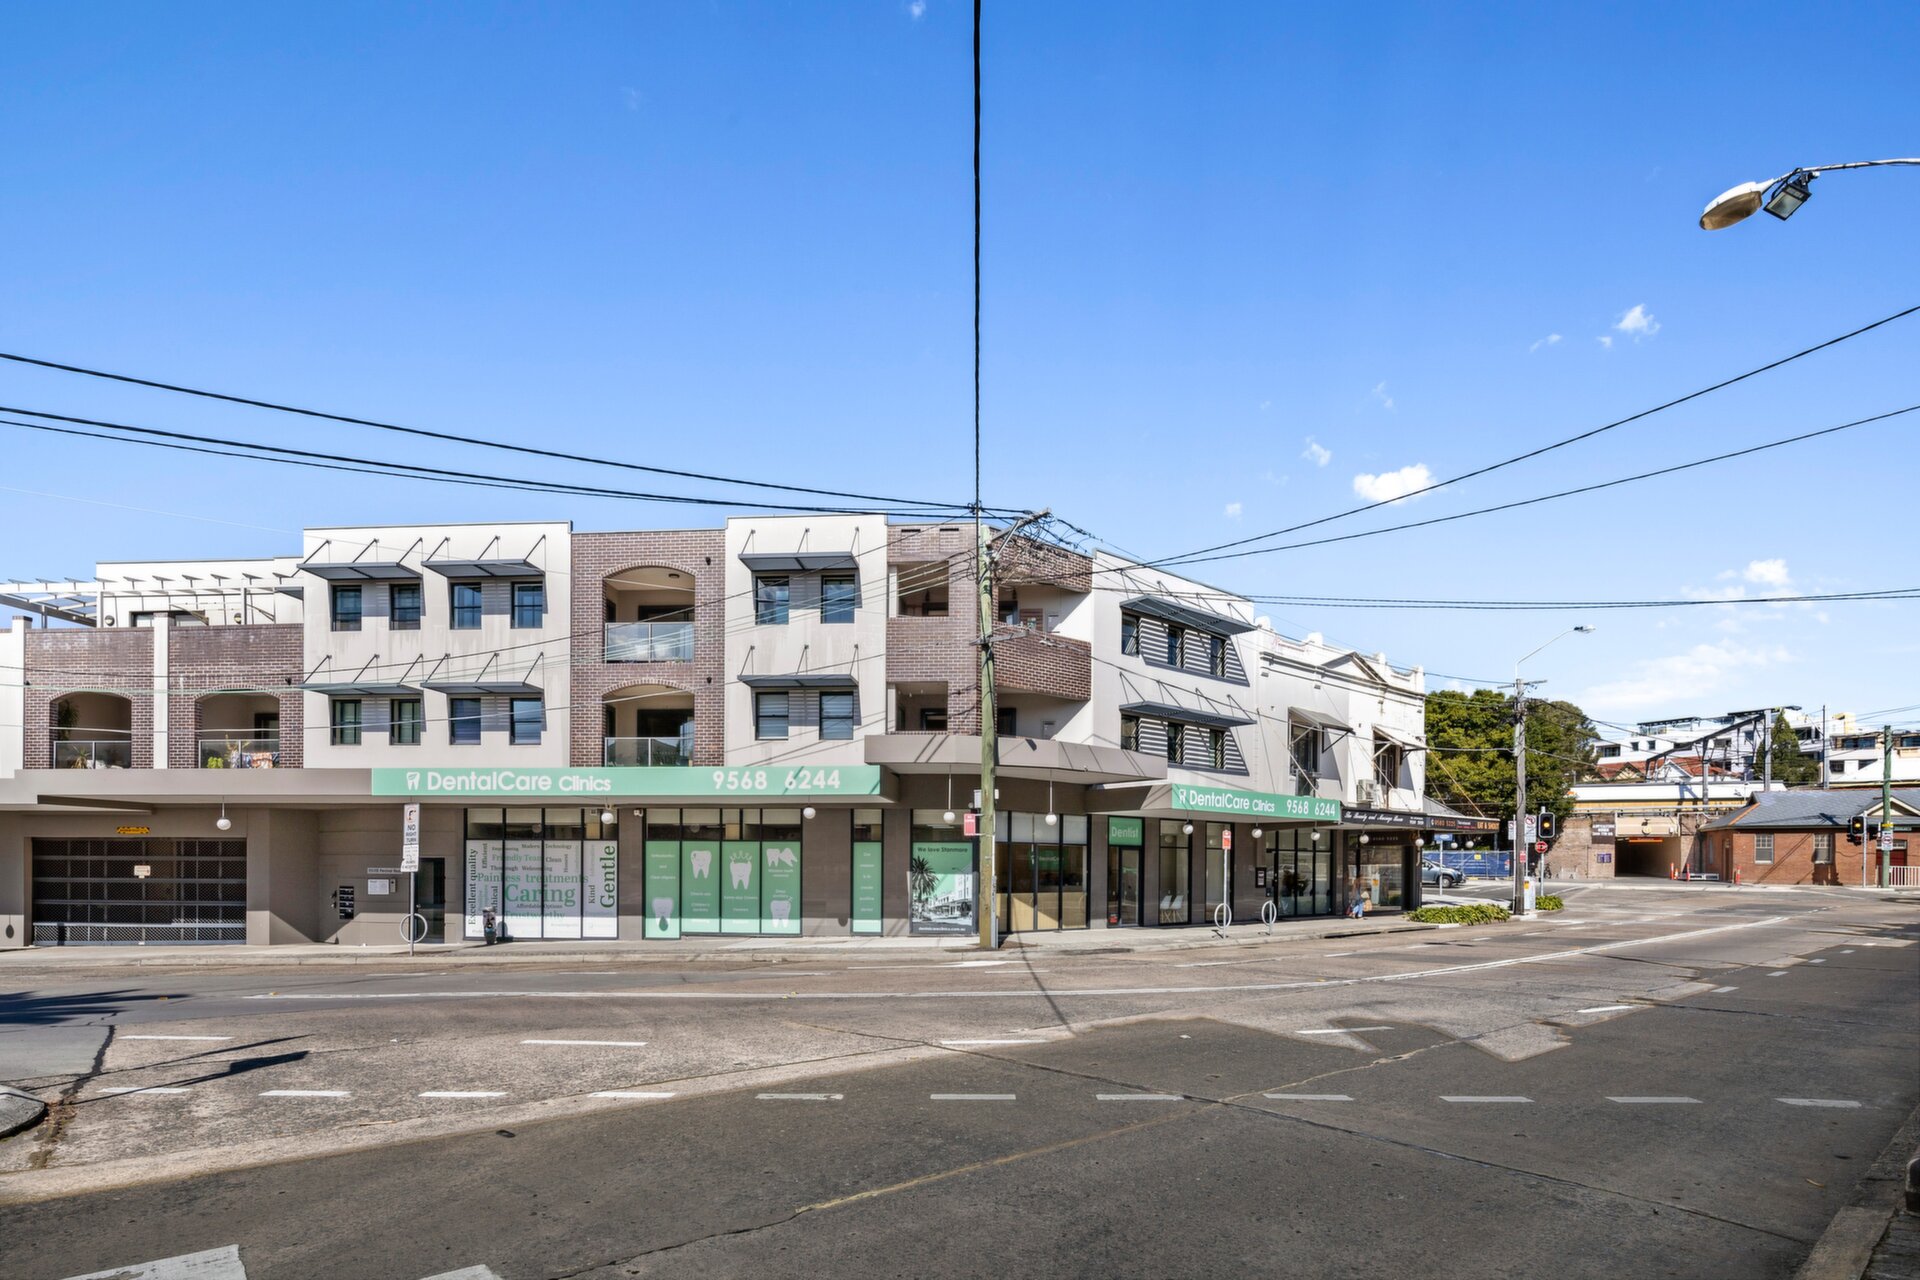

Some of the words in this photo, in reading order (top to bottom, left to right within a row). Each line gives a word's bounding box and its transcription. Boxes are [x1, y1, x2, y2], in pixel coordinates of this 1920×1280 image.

[427, 771, 552, 791] DentalCare
[558, 774, 612, 792] Clinics
[712, 769, 768, 790] 9568
[784, 768, 841, 790] 6244
[1189, 790, 1250, 811] DentalCare
[1252, 799, 1276, 813] Clinics
[1286, 799, 1310, 816] 9568
[1314, 801, 1337, 818] 6244
[1111, 826, 1140, 839] Dentist
[468, 848, 478, 881] quality
[477, 872, 521, 882] Painess
[599, 845, 616, 908] Gentle
[468, 883, 477, 925] Excellent
[504, 883, 576, 907] Caring
[588, 884, 596, 904] Kind
